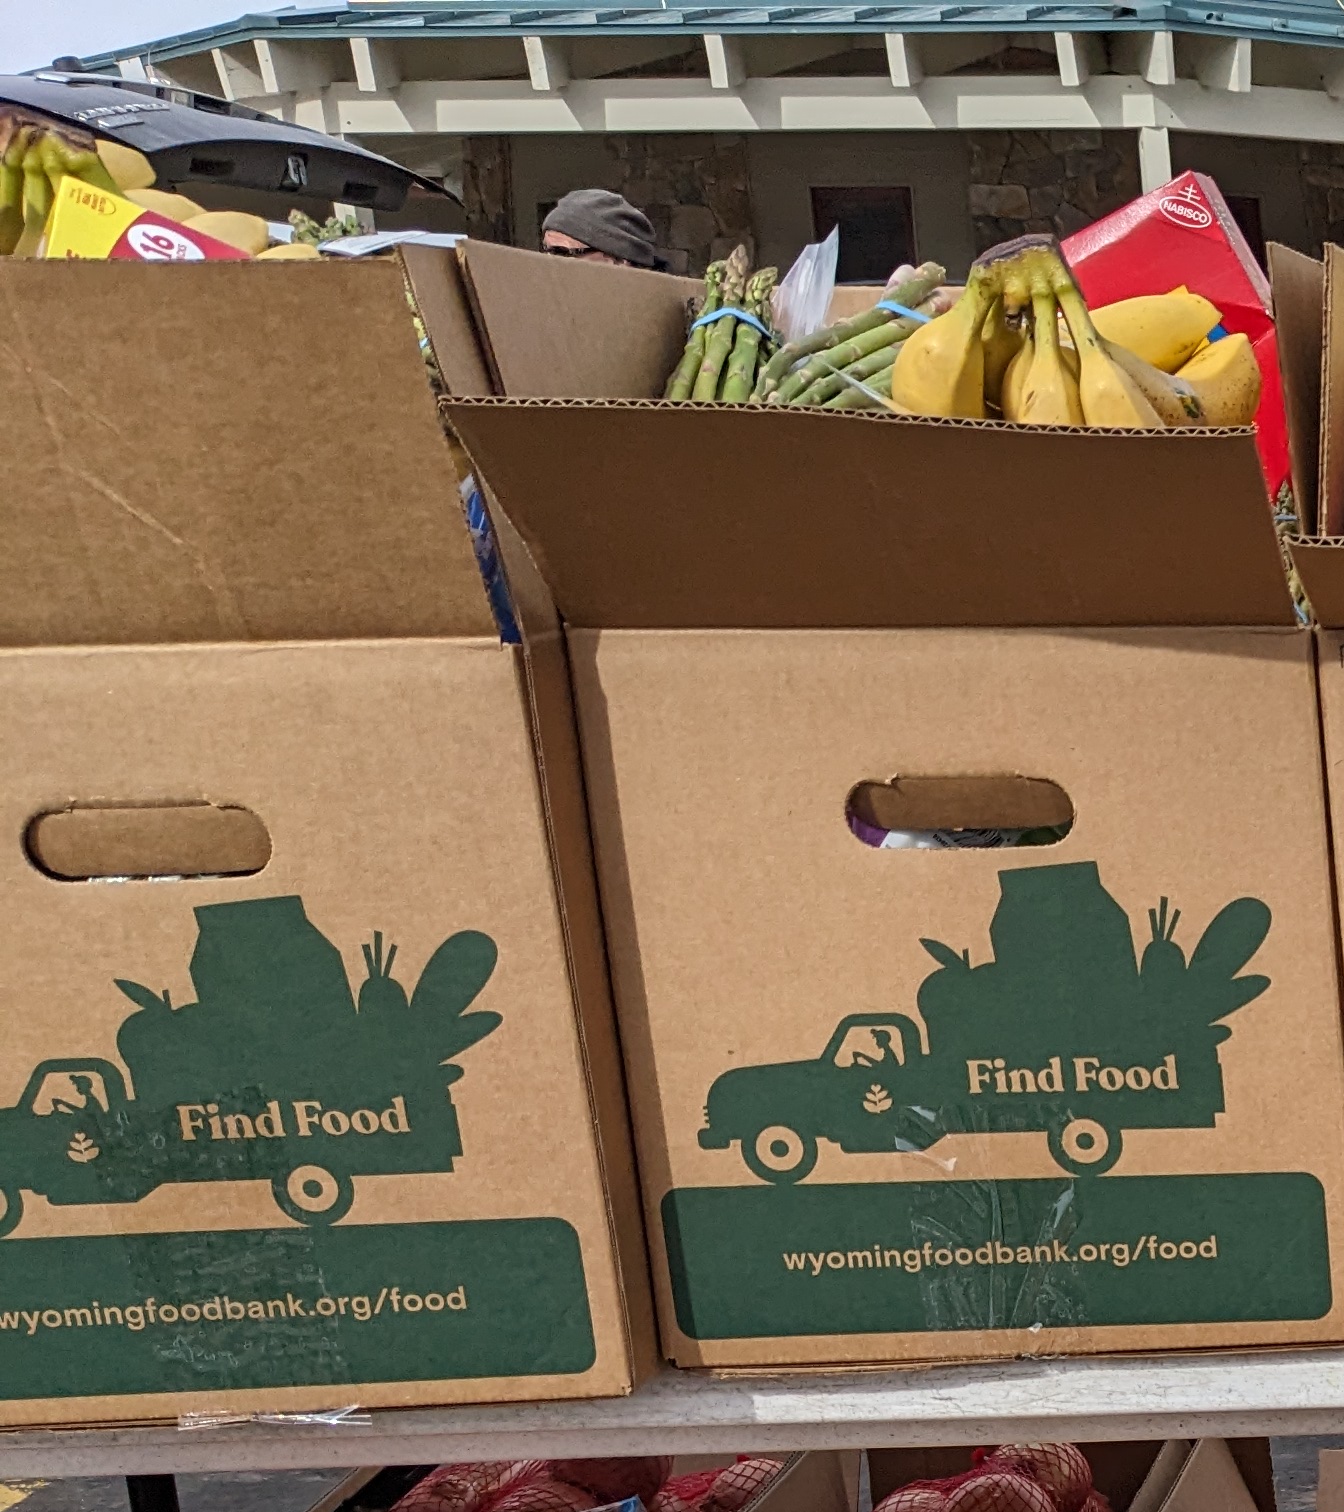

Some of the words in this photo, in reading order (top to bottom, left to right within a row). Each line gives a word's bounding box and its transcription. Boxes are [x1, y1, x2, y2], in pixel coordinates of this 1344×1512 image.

[1163, 200, 1208, 223] NABISCO
[966, 1057, 1064, 1095] Find
[1073, 1054, 1179, 1092] Food
[177, 1100, 286, 1142] Find
[293, 1096, 410, 1137] Food
[783, 1235, 1218, 1275] wyomingfoodbank.org/food
[0, 1286, 467, 1335] wyomingfoodbank.org/food
